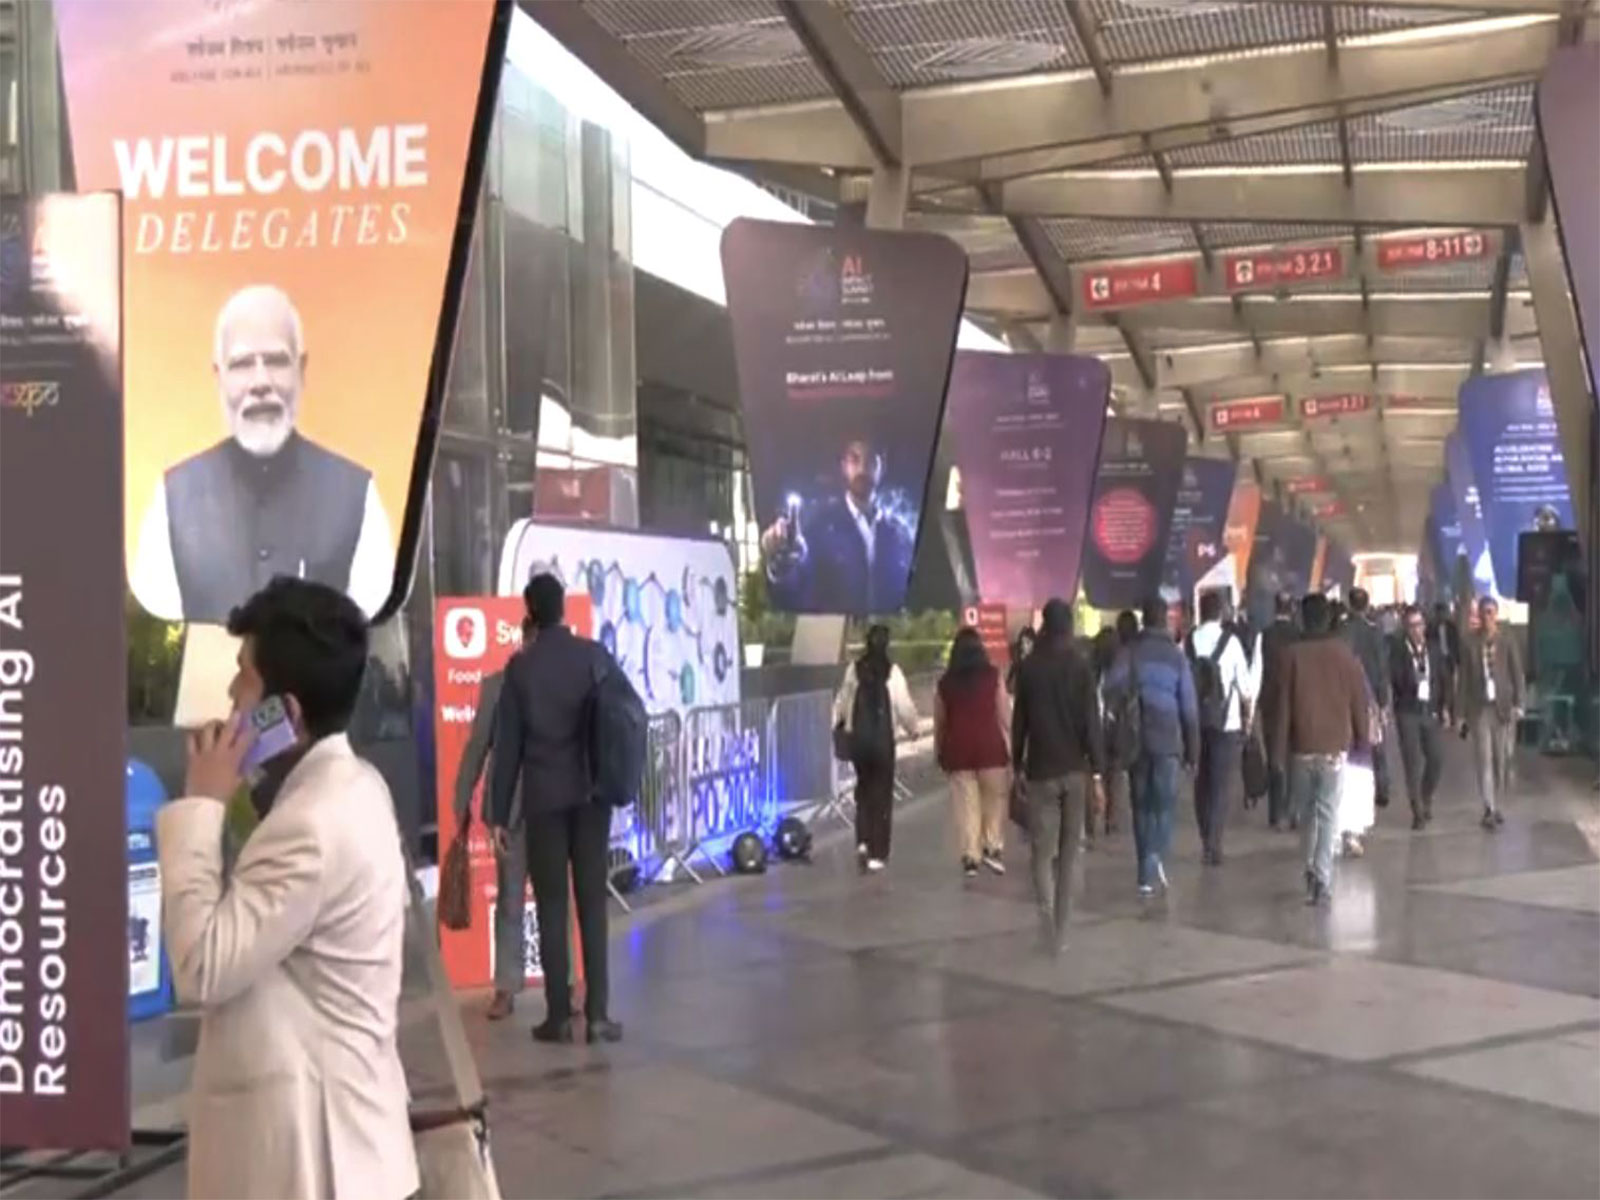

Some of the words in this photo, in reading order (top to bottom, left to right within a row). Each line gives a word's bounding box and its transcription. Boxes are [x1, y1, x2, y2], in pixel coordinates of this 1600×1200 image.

[113, 124, 428, 199] WELCOME
[135, 202, 411, 254] DELEGATES
[1152, 272, 1161, 291] 4
[0, 575, 23, 630] AI
[448, 668, 481, 685] Food
[0, 649, 34, 1093] Democratising
[34, 784, 66, 1095] Resources
